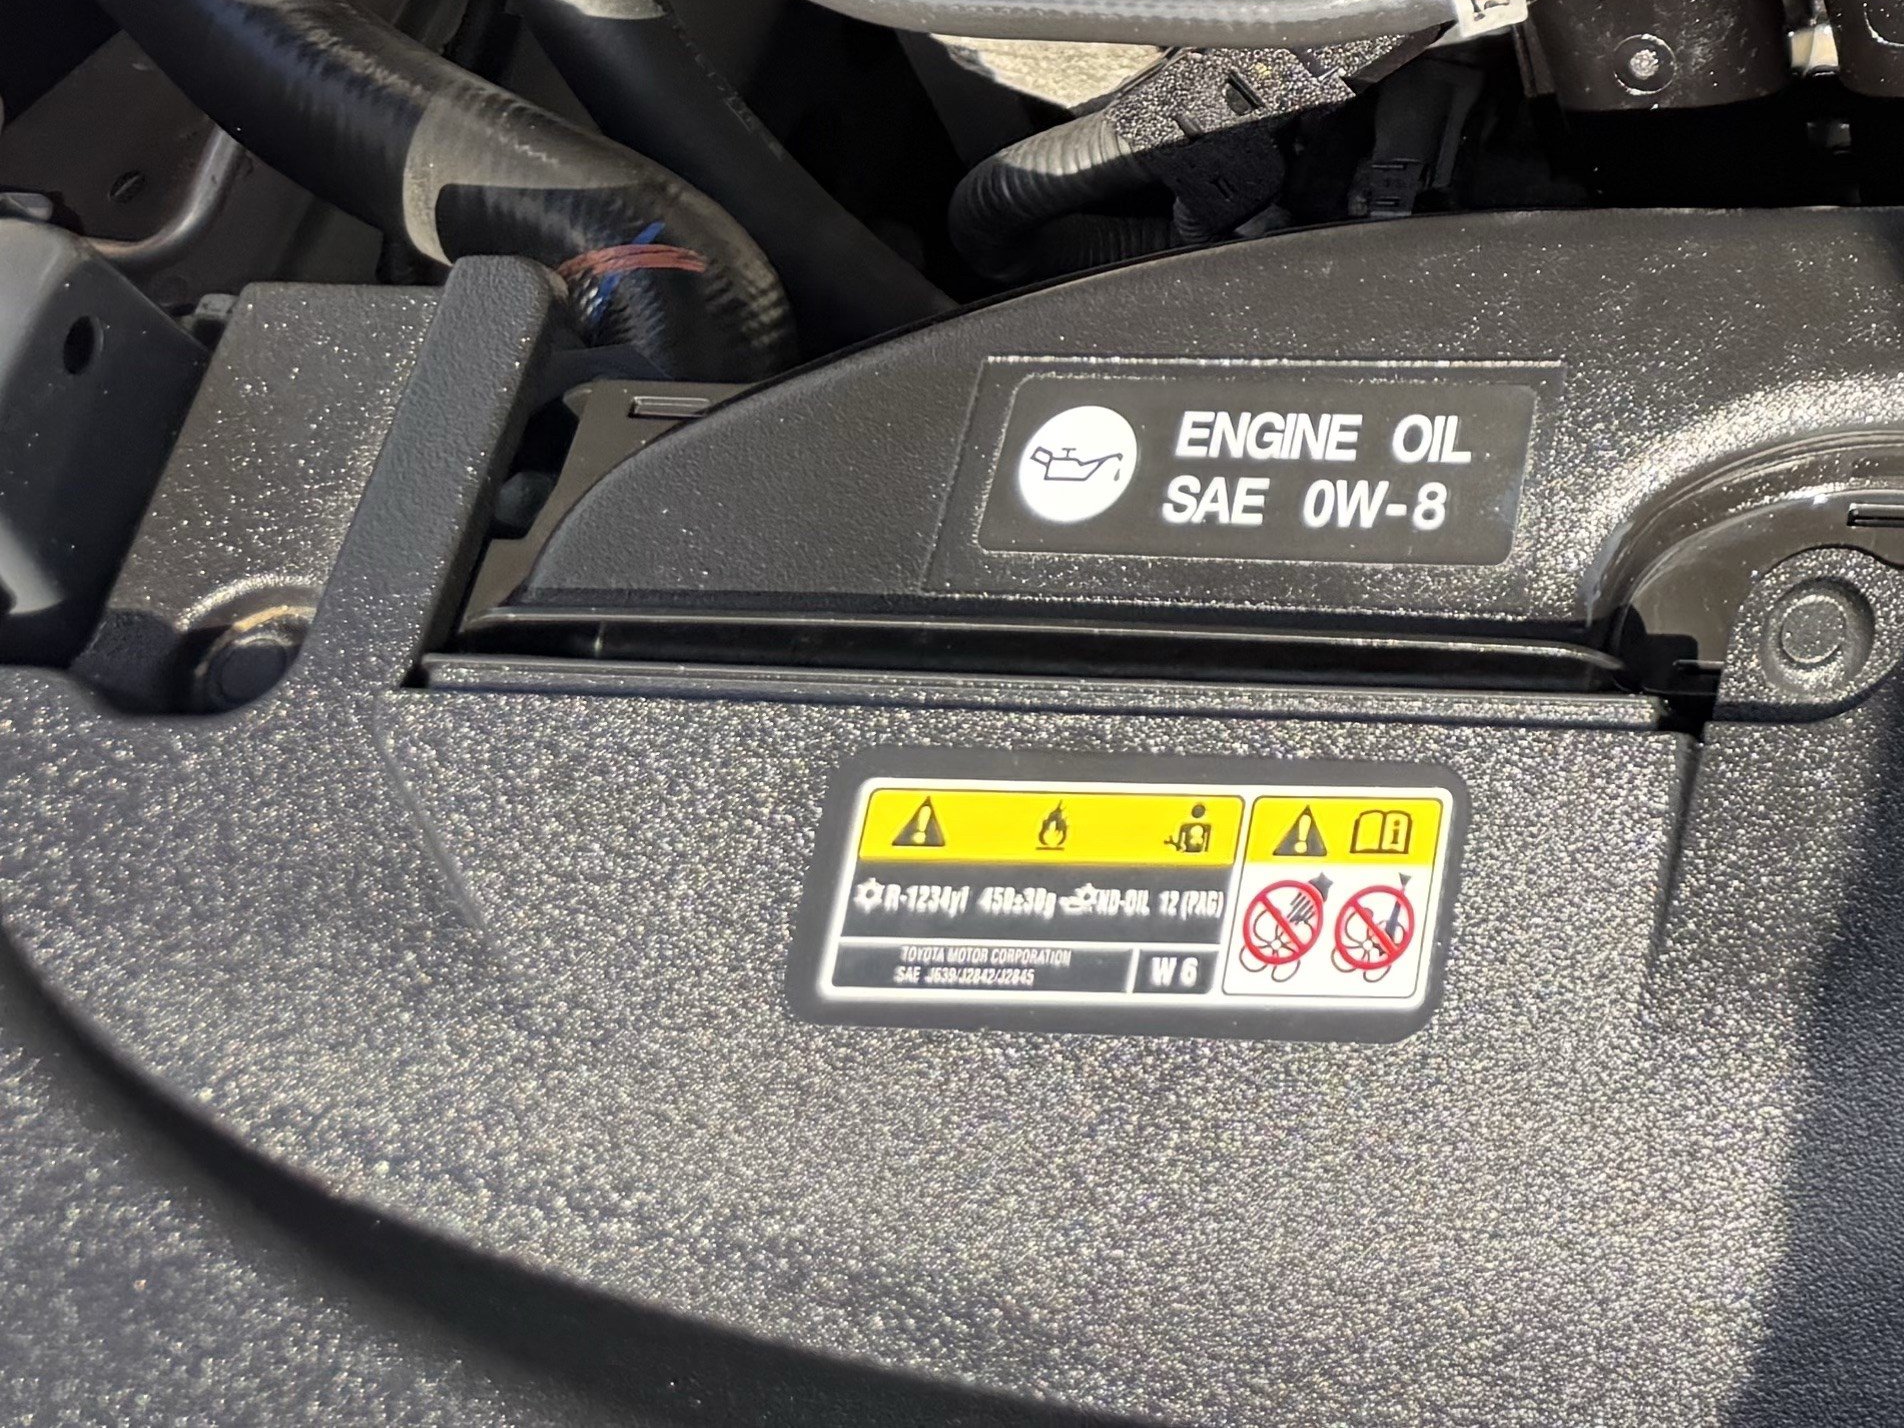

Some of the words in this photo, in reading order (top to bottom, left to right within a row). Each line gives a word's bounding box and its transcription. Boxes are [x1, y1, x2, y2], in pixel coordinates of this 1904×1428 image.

[1173, 409, 1363, 464] ENGINE
[1391, 414, 1473, 465] OIL
[1161, 476, 1271, 526] SAE
[1301, 479, 1448, 531] 0W-8
[901, 946, 946, 963] TOYOTA
[946, 947, 988, 964] MOTOR
[990, 948, 1072, 966] CORPORATION
[894, 966, 920, 983] SAE
[1179, 958, 1199, 986] 6
